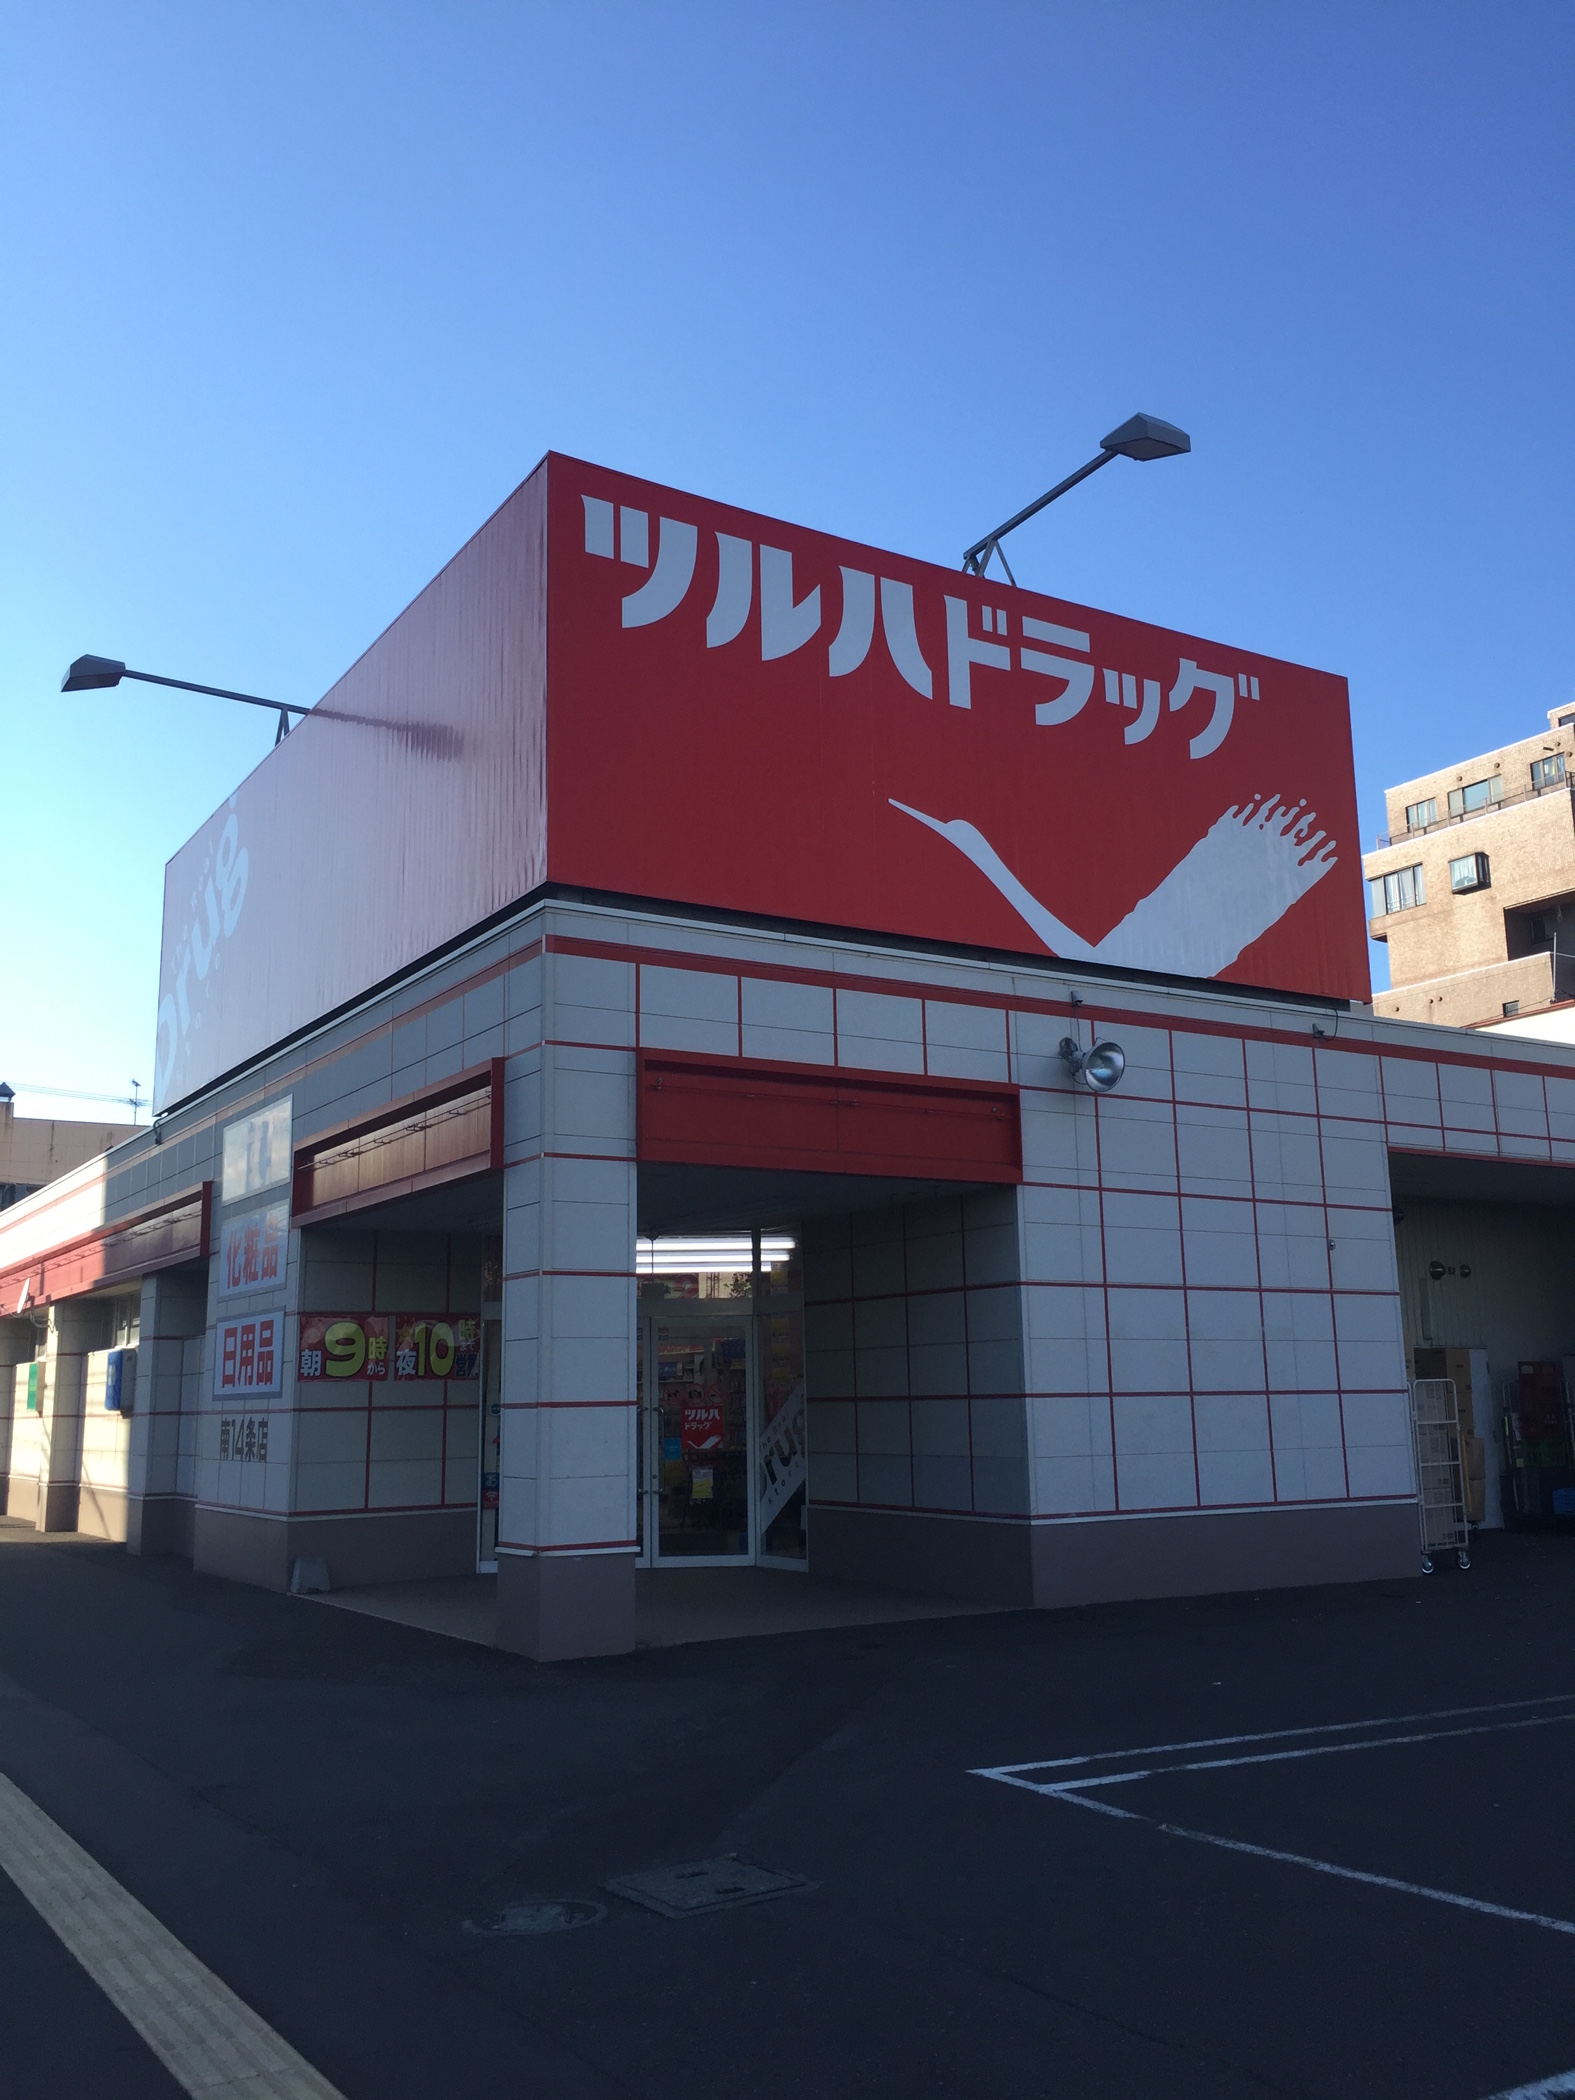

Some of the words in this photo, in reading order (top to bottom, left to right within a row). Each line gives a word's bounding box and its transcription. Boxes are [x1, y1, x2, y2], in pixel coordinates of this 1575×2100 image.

[581, 494, 1260, 760] ツルハドラッグ
[226, 1216, 279, 1290] 化粧品
[222, 1320, 274, 1388] 日用品
[220, 1419, 268, 1461] 南14条店
[684, 1408, 721, 1422] ツルハ
[684, 1421, 714, 1431] ドラッグ
